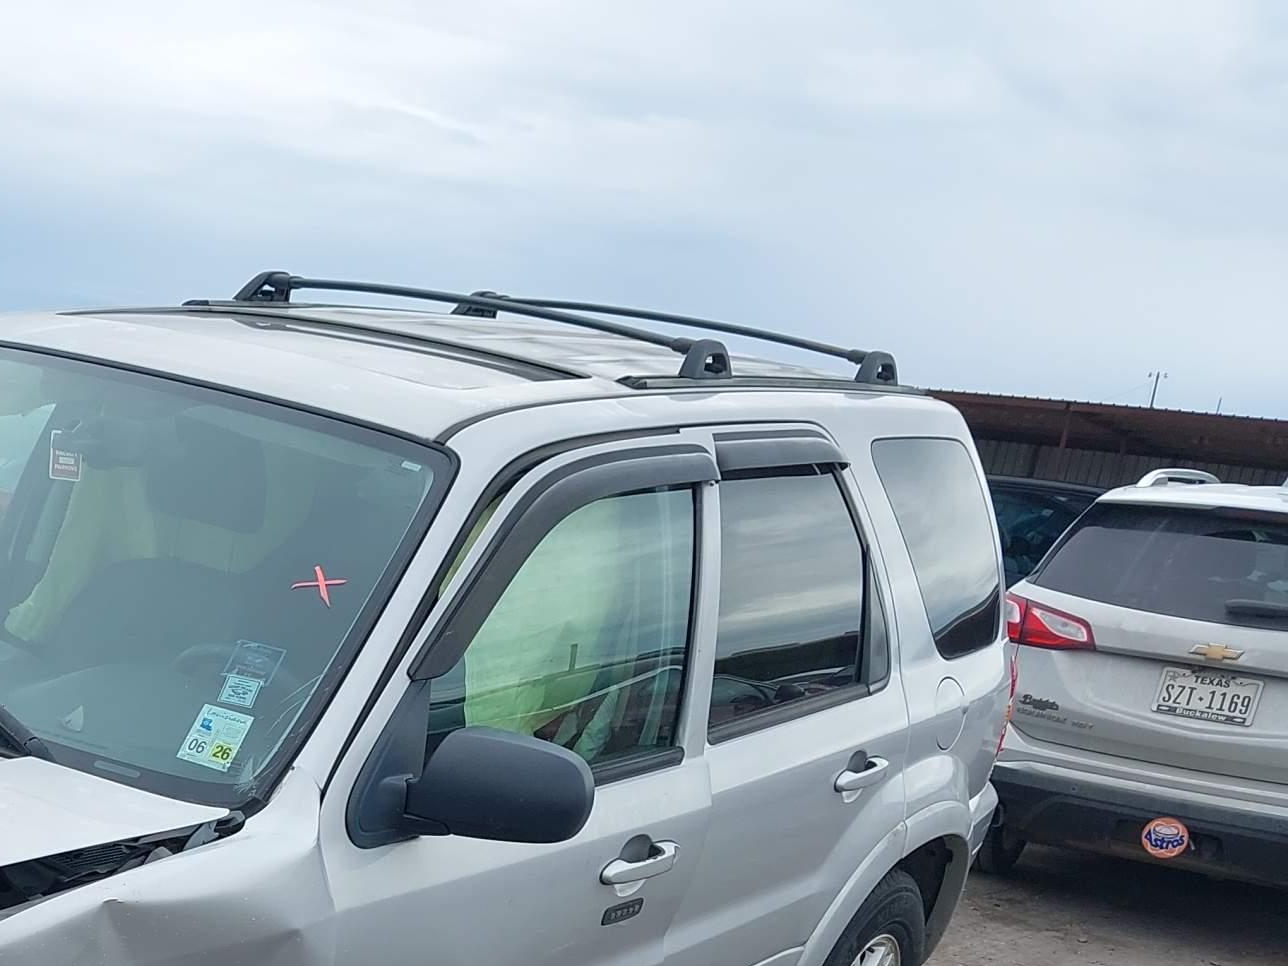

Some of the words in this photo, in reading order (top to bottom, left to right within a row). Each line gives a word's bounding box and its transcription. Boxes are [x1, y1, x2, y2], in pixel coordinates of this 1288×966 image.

[1194, 674, 1231, 689] TEXAS
[188, 738, 207, 753] 06
[212, 745, 232, 760] 26
[1144, 828, 1185, 850] Astros
